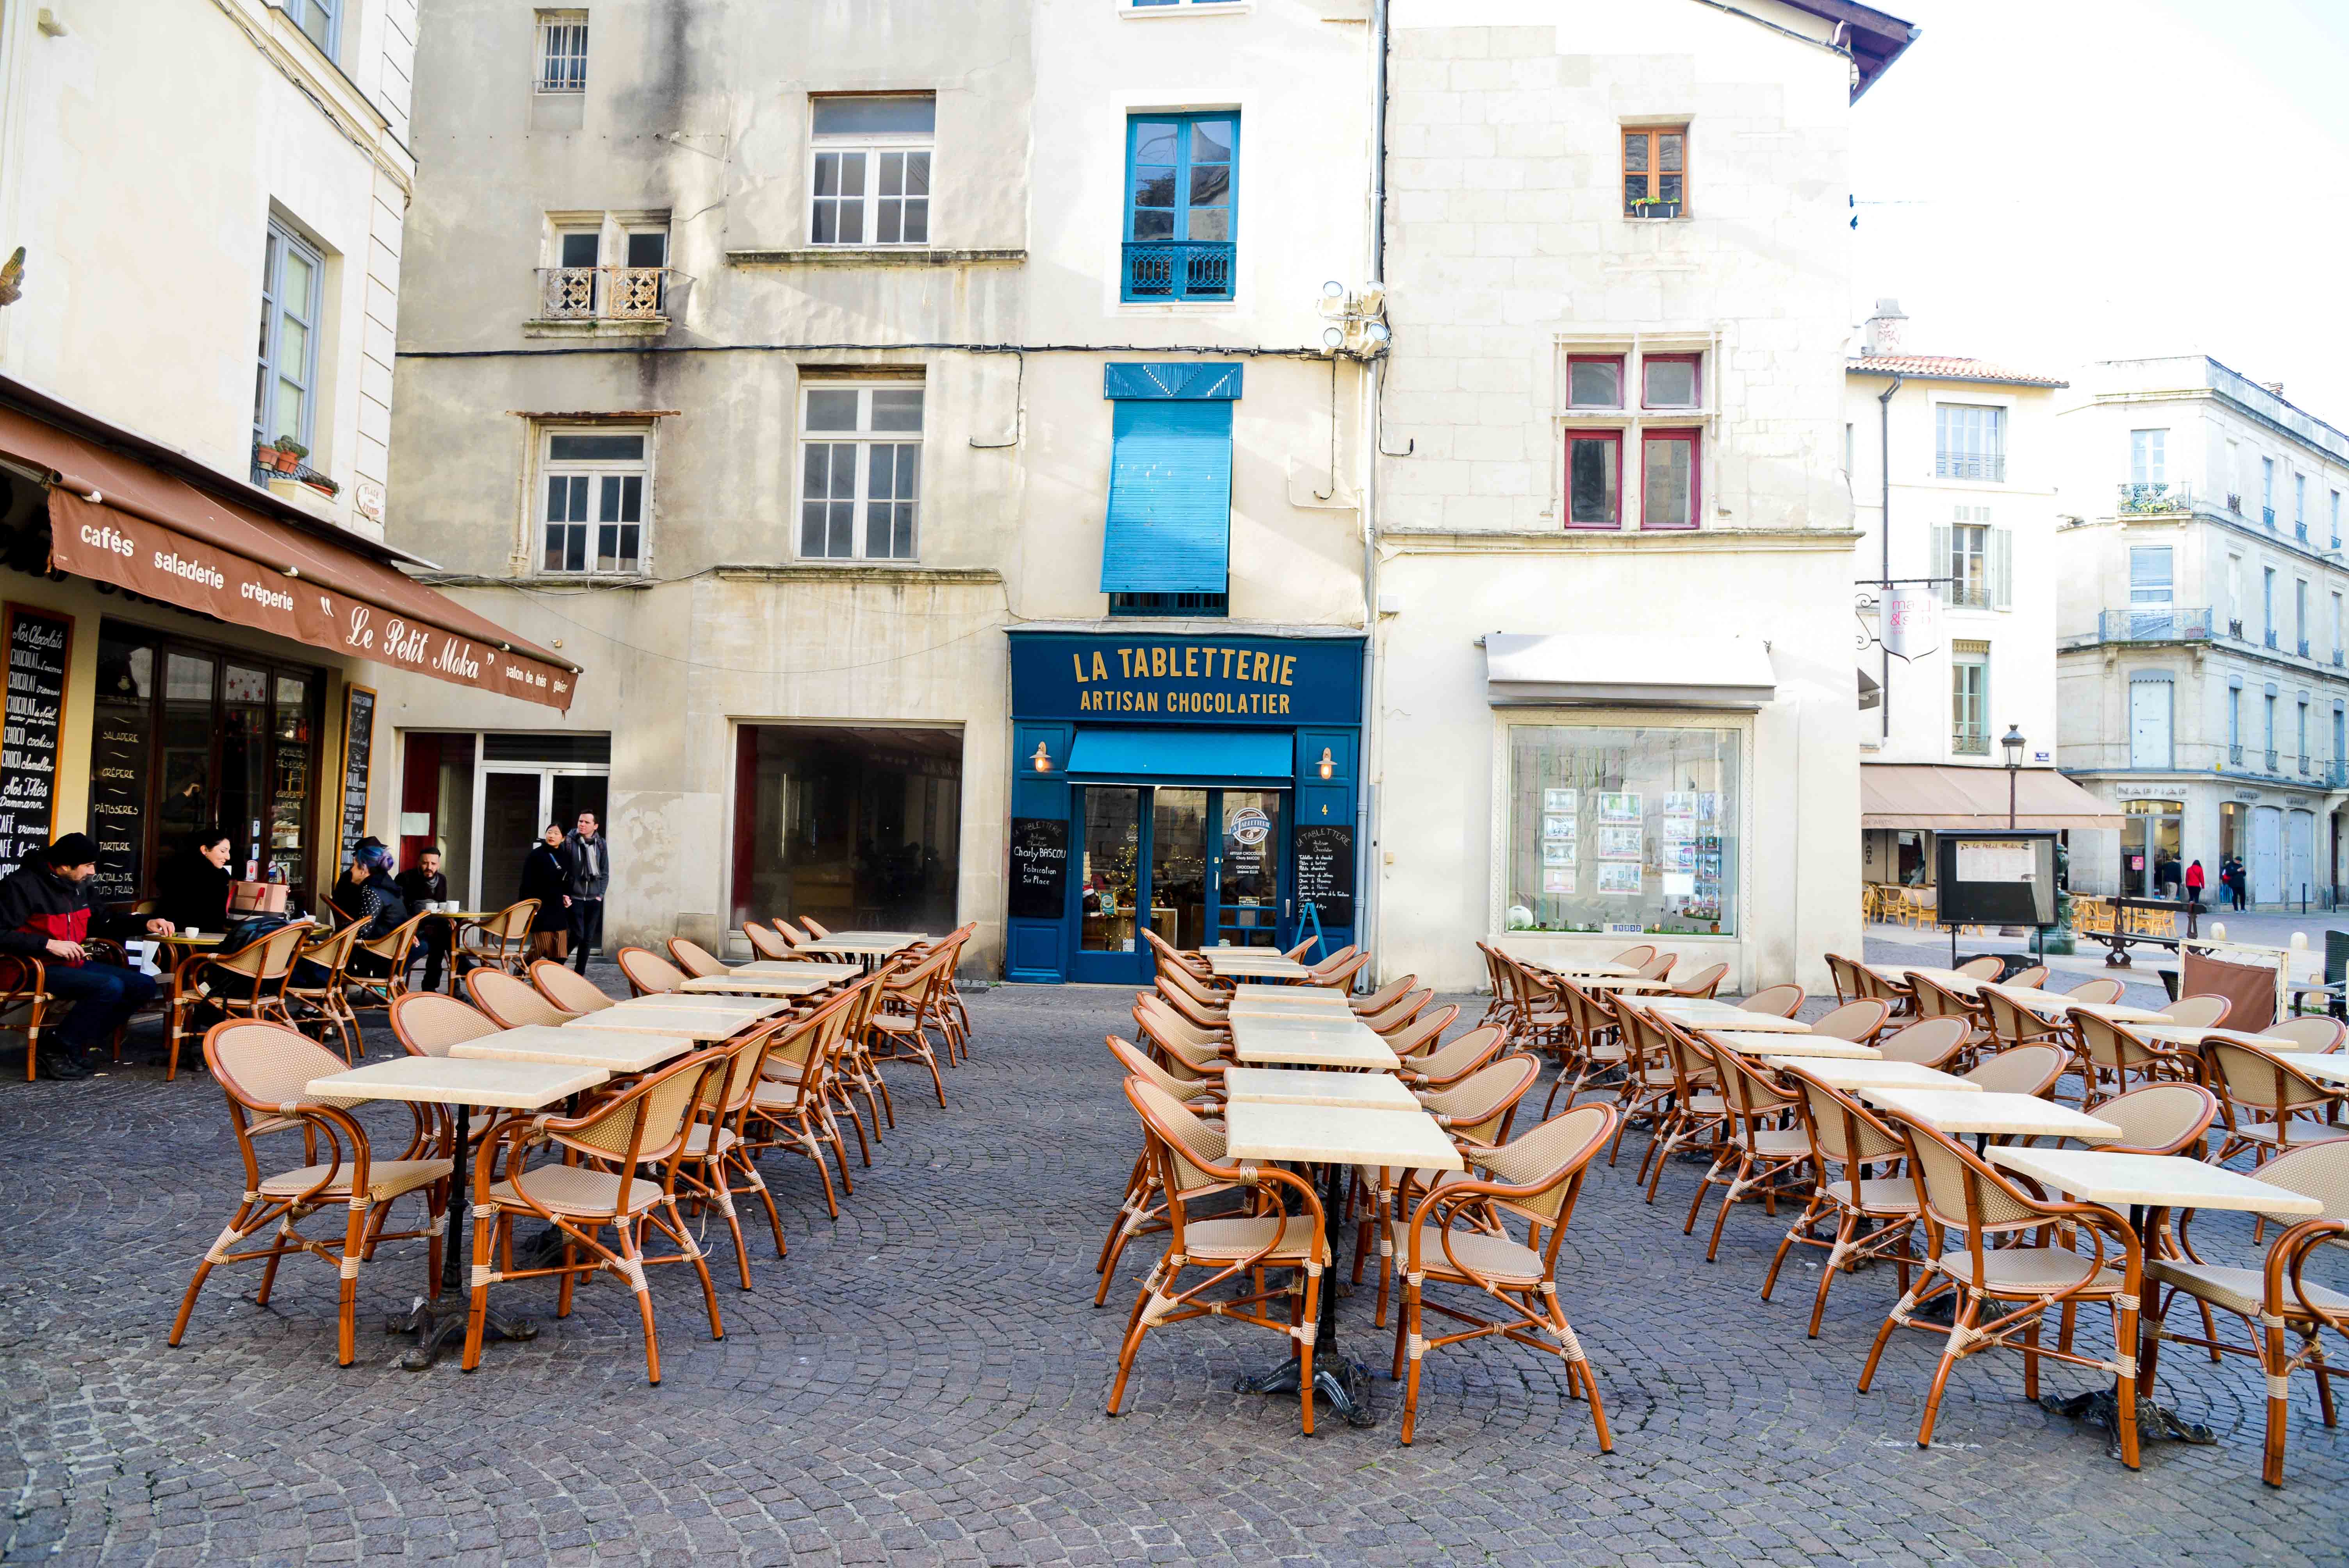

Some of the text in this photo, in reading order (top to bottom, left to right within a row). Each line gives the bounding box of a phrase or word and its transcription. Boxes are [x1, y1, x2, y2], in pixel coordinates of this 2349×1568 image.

[81, 524, 294, 611] cafés saladerie crèperie
[12, 622, 62, 649] Nos Chocolats
[346, 606, 479, 679] Le Petit Moka
[10, 649, 39, 668] CHOCOLAT
[1073, 647, 1297, 686] LA TABLETTERIE
[8, 671, 37, 692] CHOCOLAT
[506, 665, 523, 681] salon
[526, 669, 533, 684] de
[6, 695, 36, 715] CHOCOLAT
[1080, 691, 1290, 714] ARTISAN CHOCOLATIER
[4, 726, 54, 748] CHOCO cookies
[1, 750, 21, 768] CHOCO
[4, 776, 48, 797] Nos Thés
[0, 796, 45, 809] Dammann
[1322, 804, 1328, 815] 4
[1302, 828, 1351, 846] TABLETTERIE
[1014, 846, 1066, 862] Charly BASCOU
[1023, 863, 1056, 875] Fabrication
[1023, 875, 1050, 885] Sur Place
